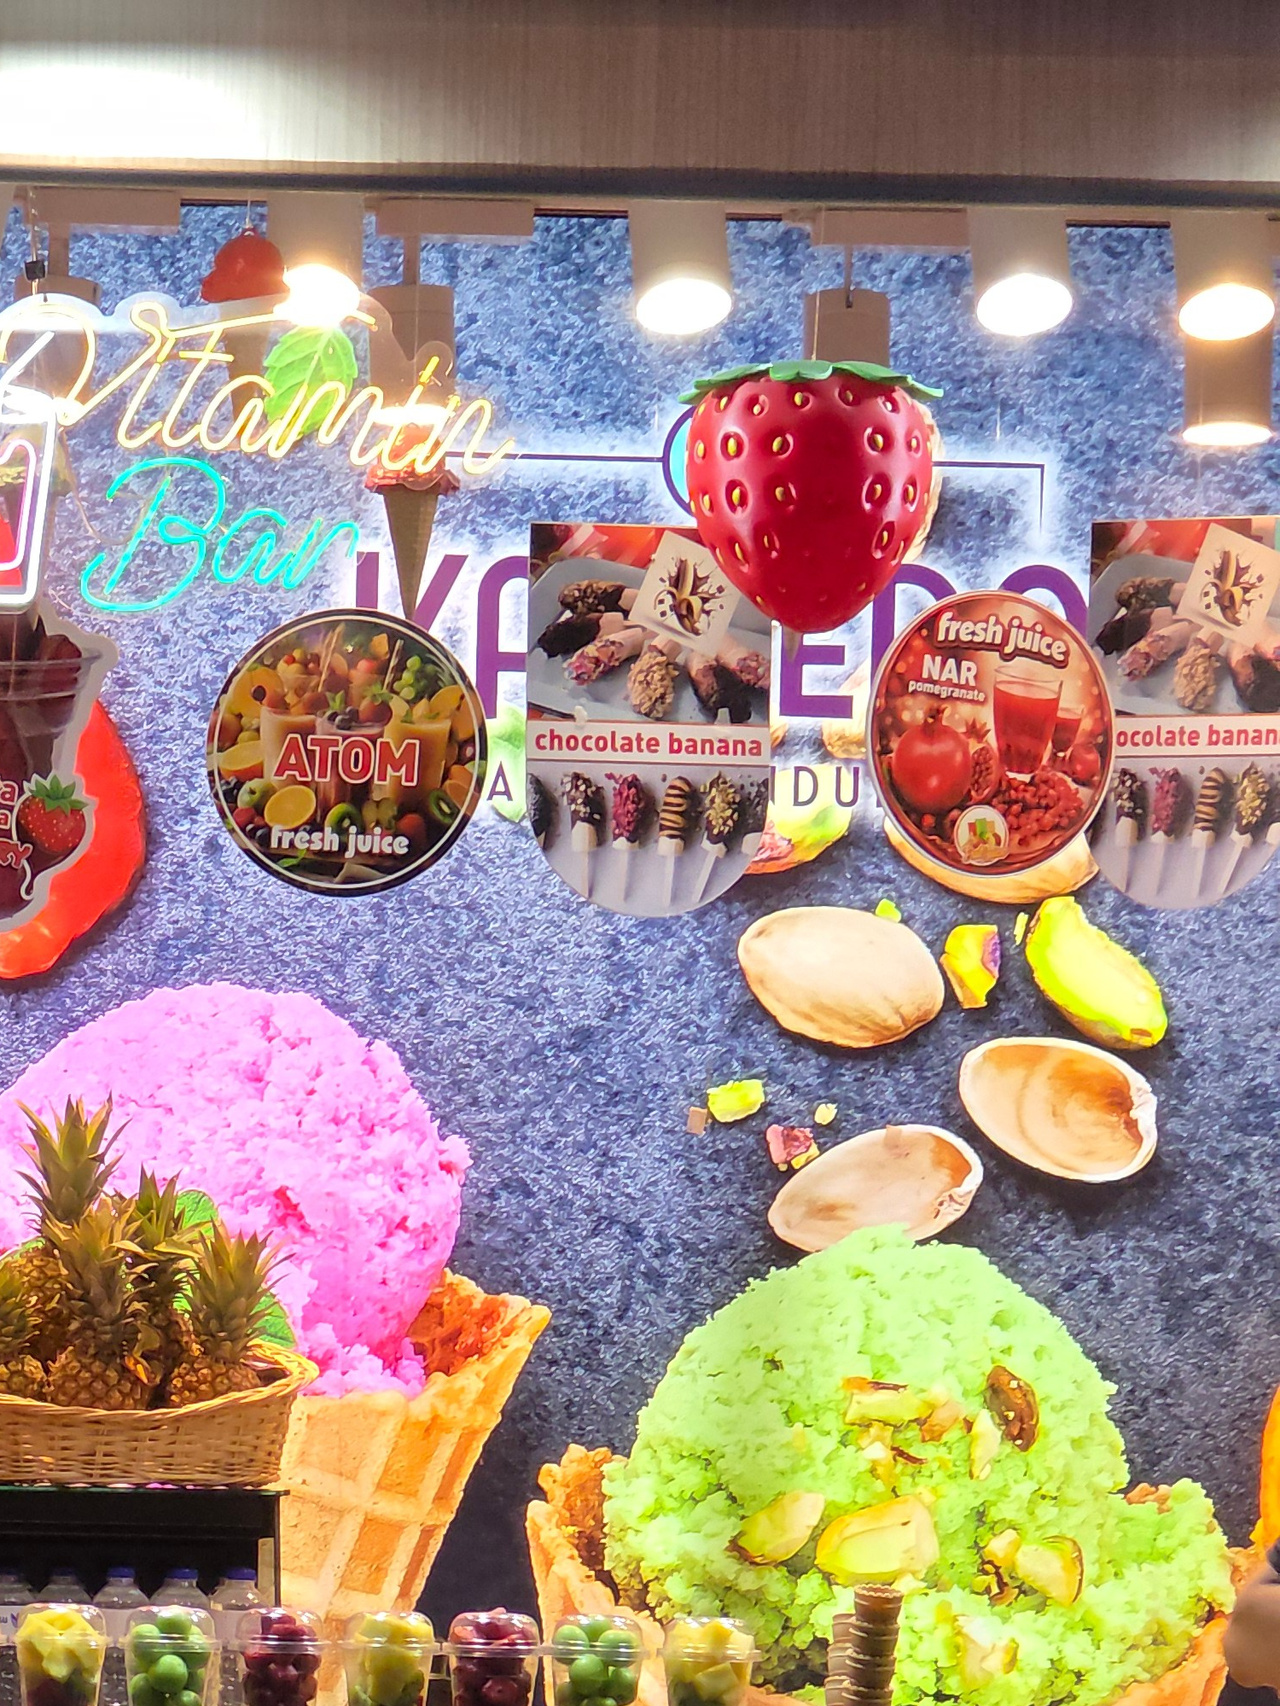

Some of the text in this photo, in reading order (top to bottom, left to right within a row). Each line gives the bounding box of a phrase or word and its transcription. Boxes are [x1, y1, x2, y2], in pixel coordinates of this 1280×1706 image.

[80, 457, 360, 613] Bar
[936, 611, 1068, 662] fresh juice
[921, 654, 977, 687] NAR
[908, 680, 986, 702] pomegranate
[534, 728, 763, 758] chocolate banana
[1115, 724, 1200, 748] ocolate
[273, 733, 420, 786] ATOM
[270, 824, 410, 859] fresh juice
